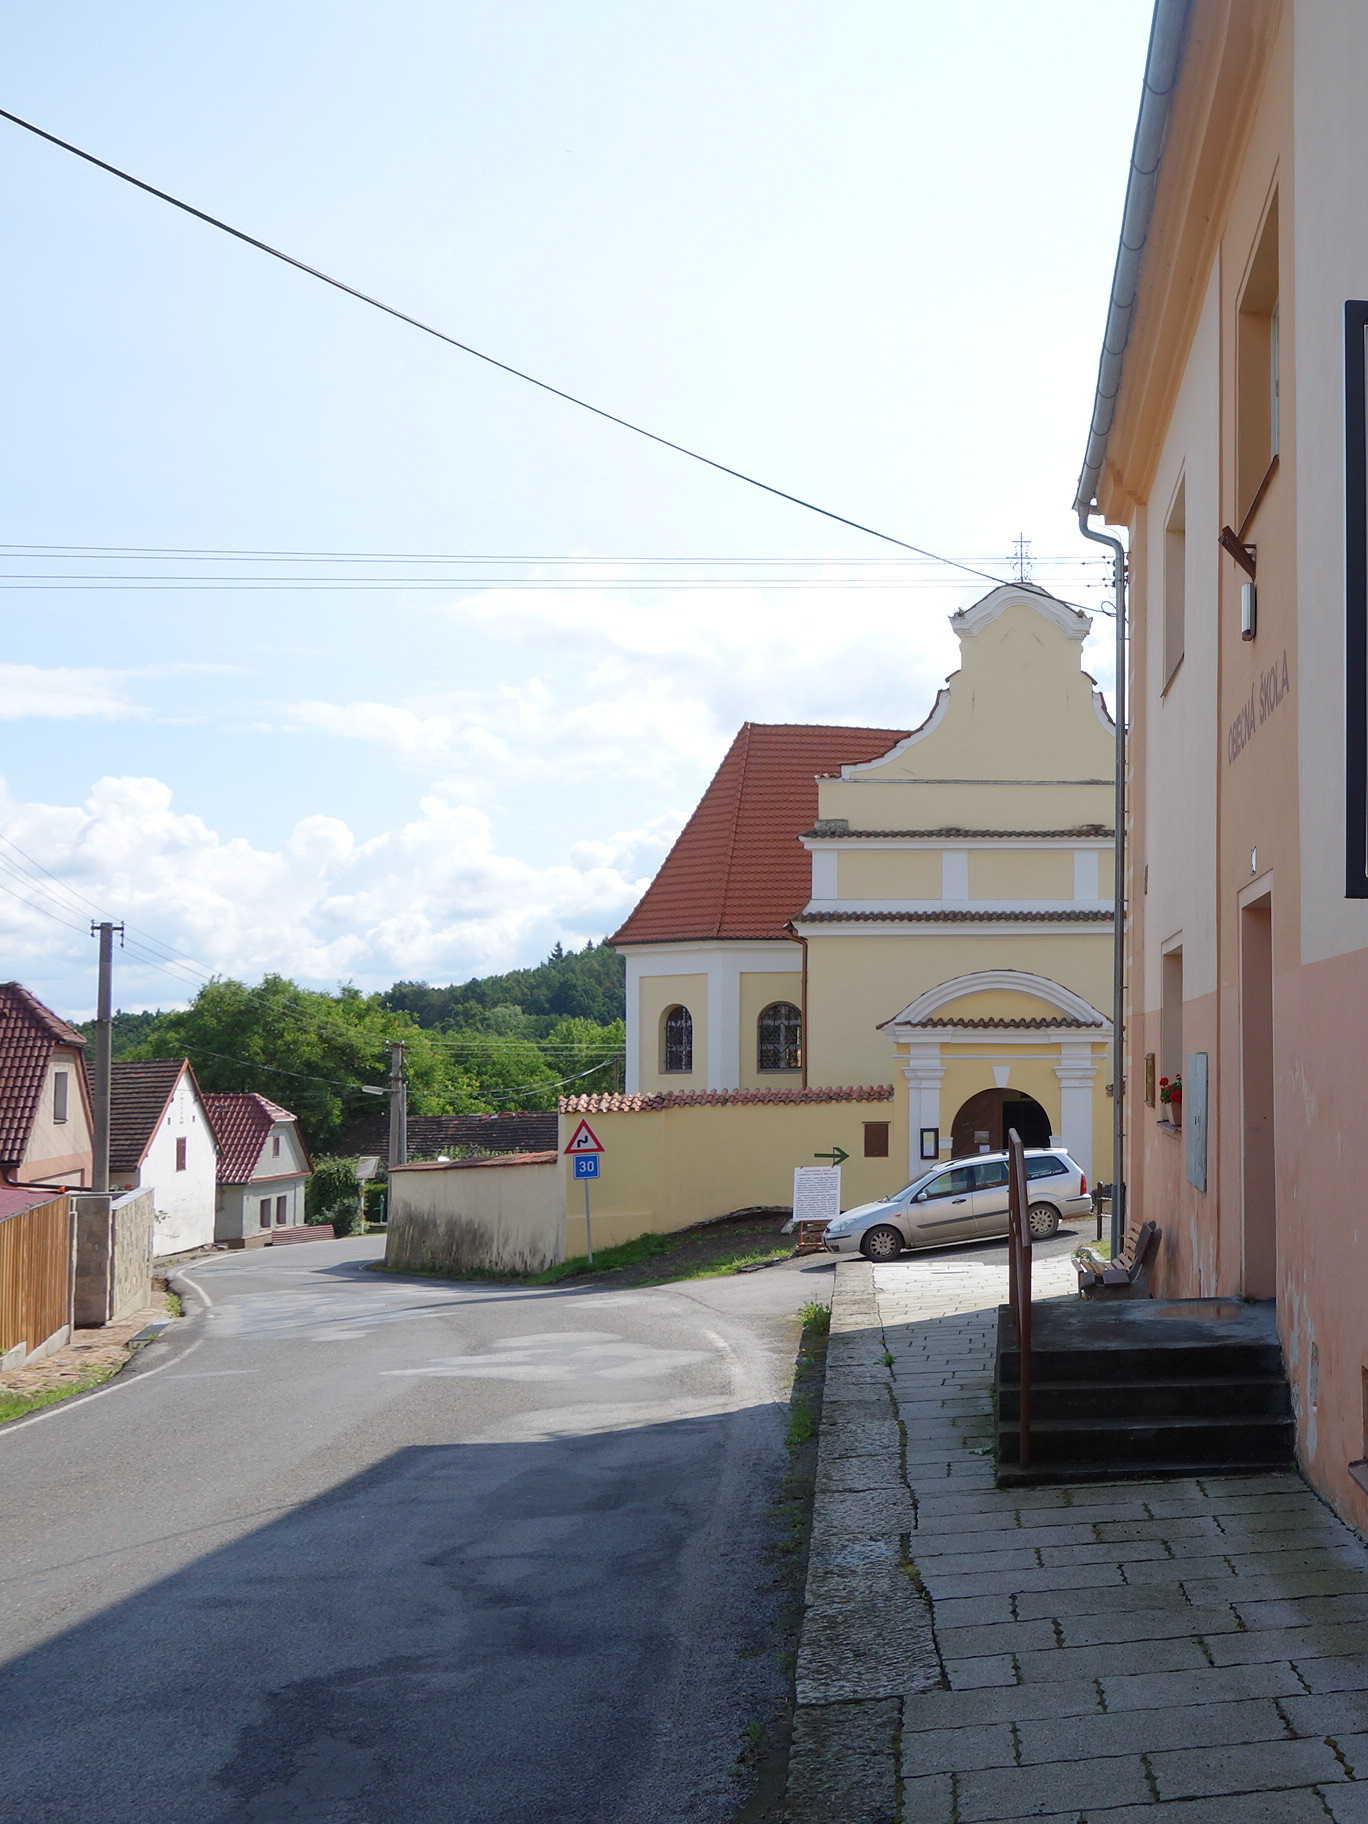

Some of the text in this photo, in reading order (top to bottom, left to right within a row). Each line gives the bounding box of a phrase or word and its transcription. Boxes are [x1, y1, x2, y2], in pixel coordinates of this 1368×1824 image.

[1227, 649, 1290, 767] OBECNÁ ŠKOLA
[578, 1160, 595, 1173] 30
